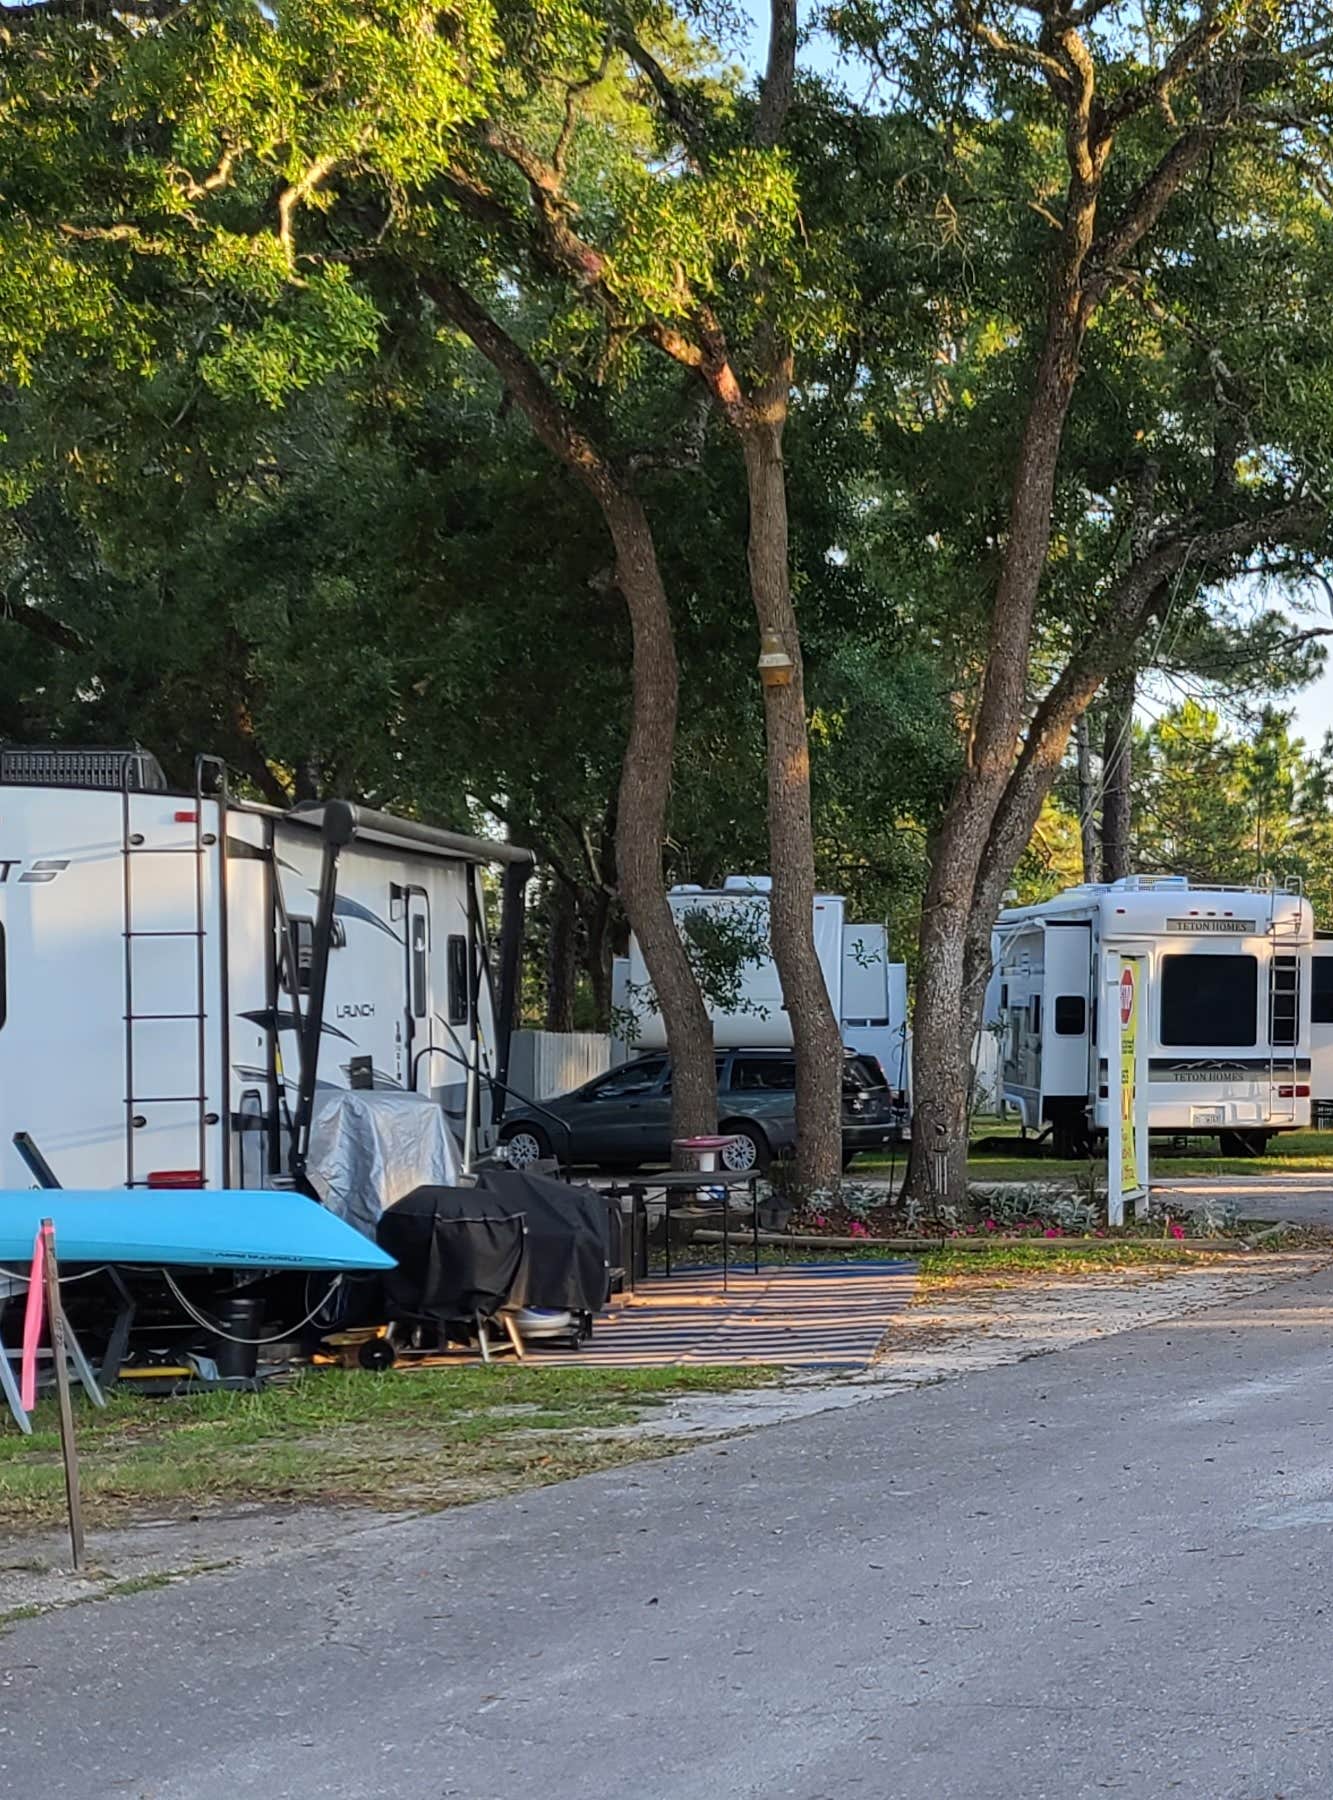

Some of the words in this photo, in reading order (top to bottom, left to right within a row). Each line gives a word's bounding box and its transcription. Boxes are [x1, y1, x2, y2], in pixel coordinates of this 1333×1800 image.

[1177, 922, 1209, 932] TETON
[1212, 922, 1247, 932] HOMES
[337, 1003, 375, 1018] LAUNCH
[1174, 1072, 1206, 1081] TETON
[1209, 1072, 1244, 1081] HOMES
